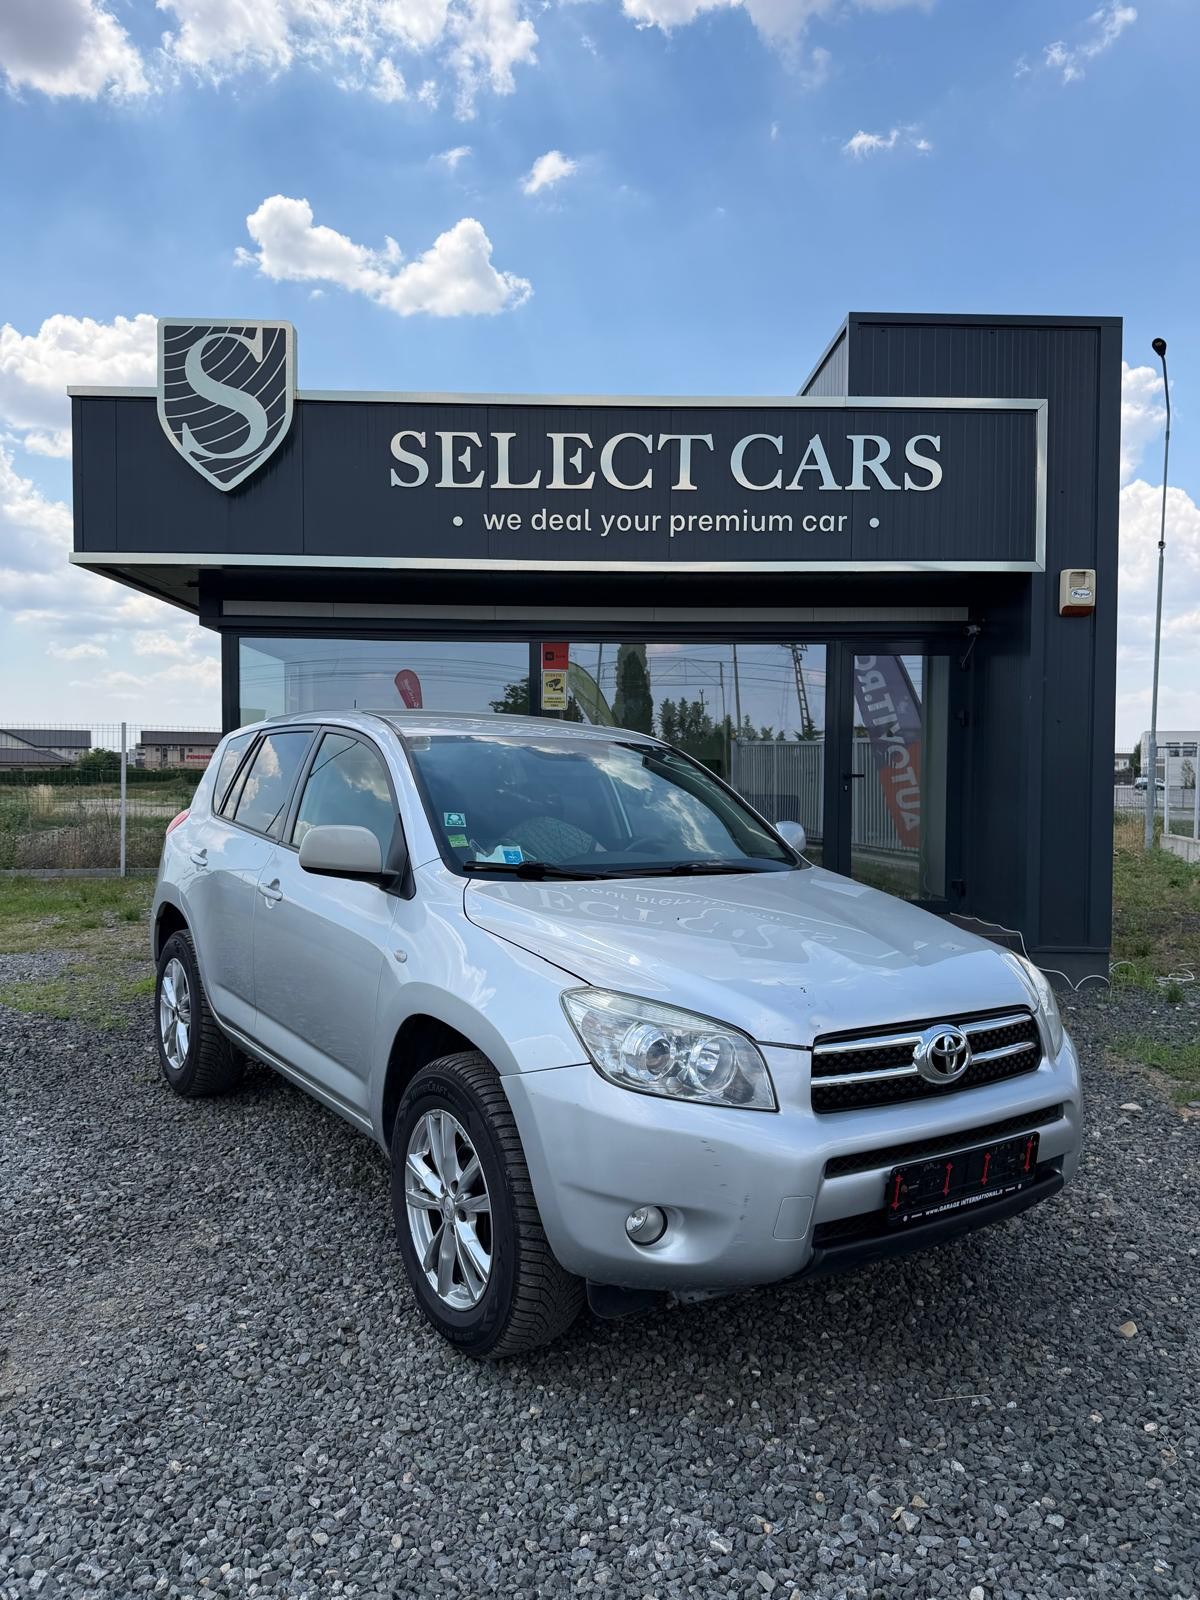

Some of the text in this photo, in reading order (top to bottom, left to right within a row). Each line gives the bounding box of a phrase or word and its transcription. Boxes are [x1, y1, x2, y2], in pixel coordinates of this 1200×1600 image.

[181, 327, 268, 459] S
[390, 430, 943, 492] SELECT CARS
[483, 508, 848, 538] we deal your premium car
